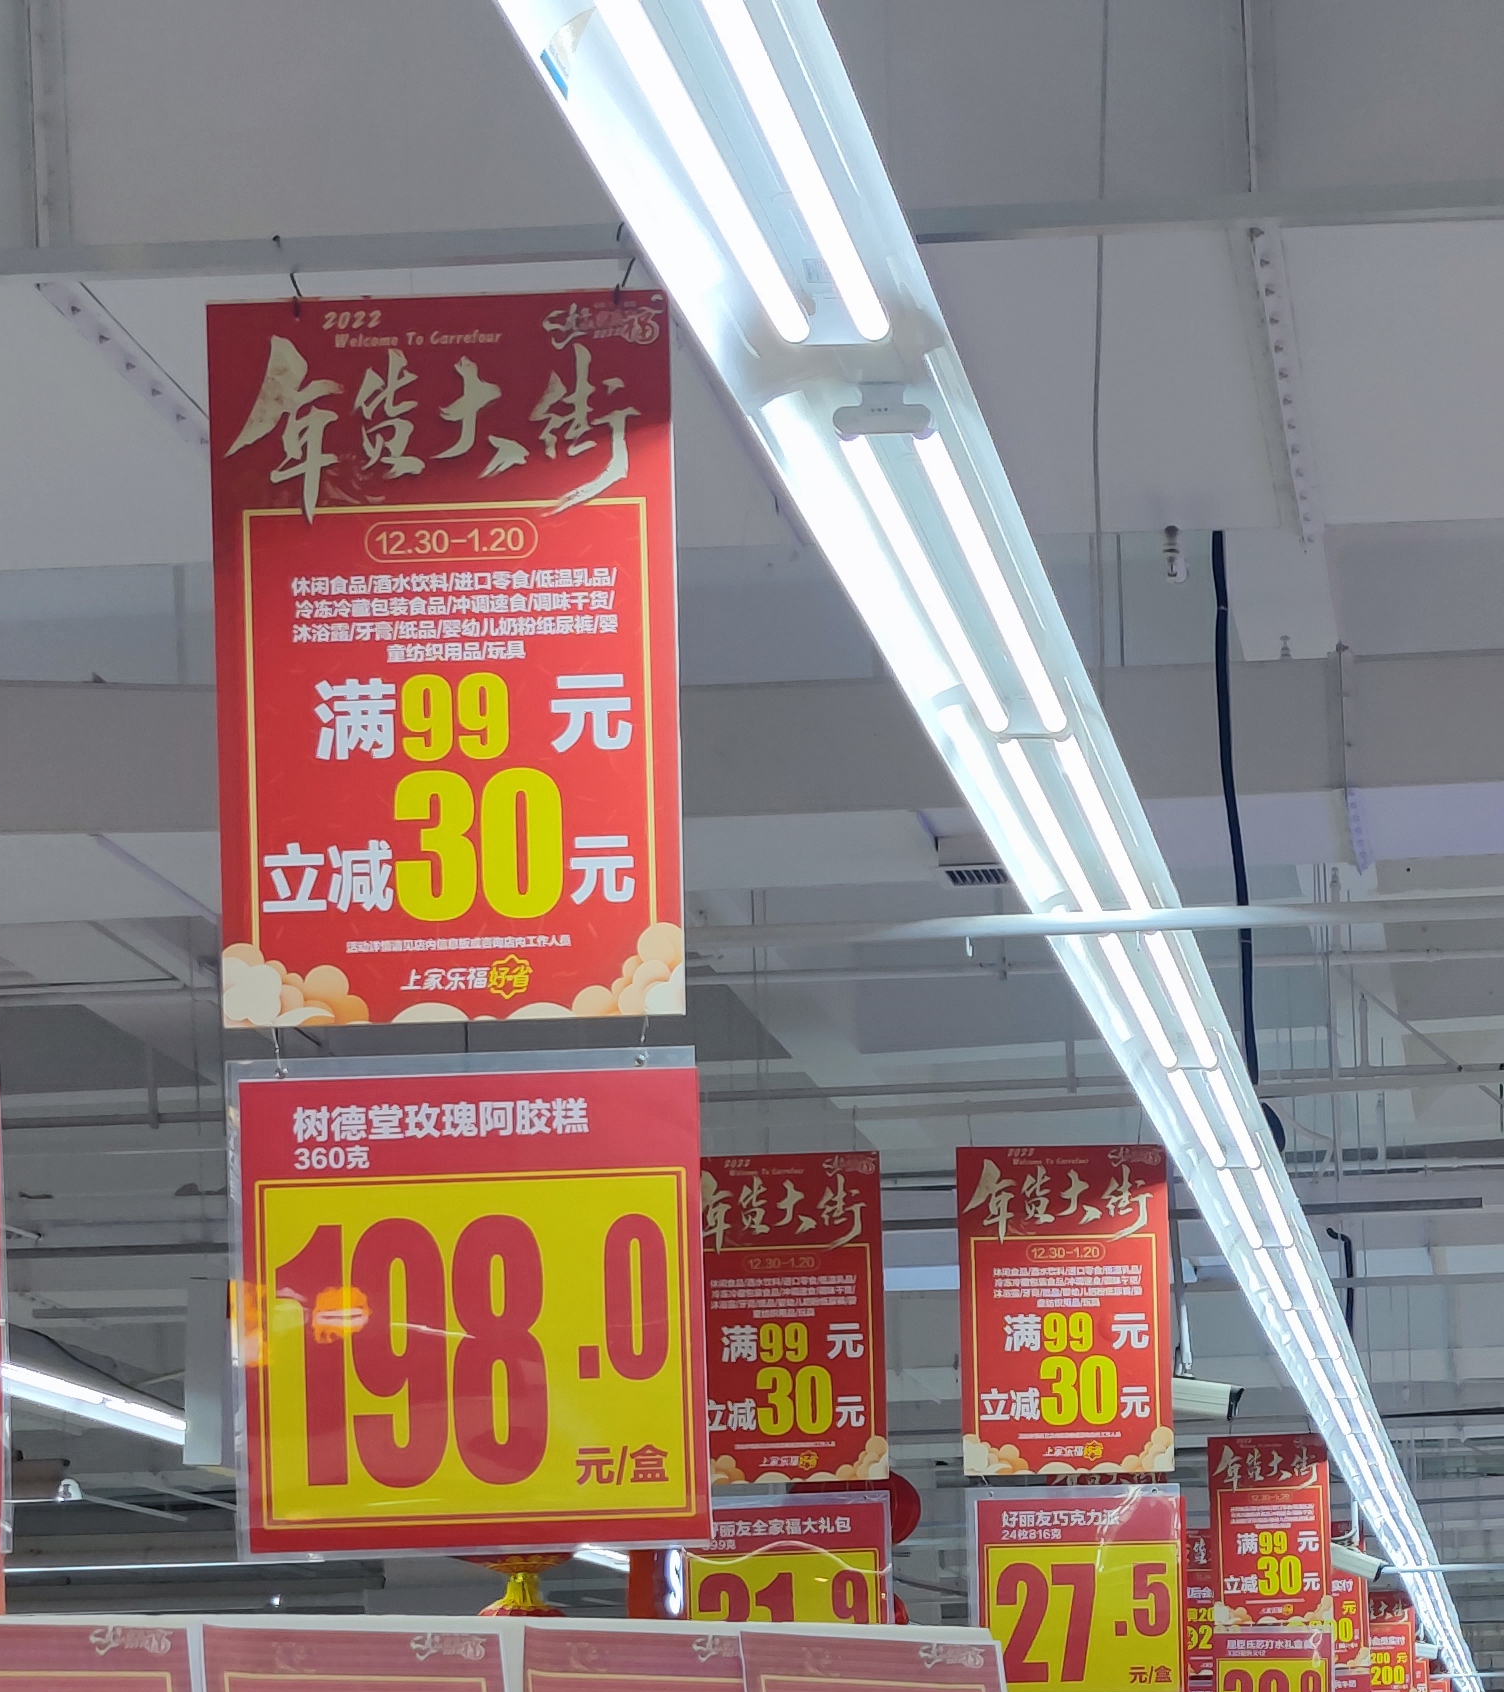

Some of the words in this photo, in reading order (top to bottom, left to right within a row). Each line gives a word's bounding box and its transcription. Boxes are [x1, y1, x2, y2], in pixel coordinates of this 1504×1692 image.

[322, 310, 382, 330] 2022
[335, 333, 398, 348] Welcome
[407, 332, 423, 346] To
[430, 330, 502, 346] Carrefour
[224, 335, 641, 525] 年货大街
[375, 527, 524, 556] 12.30-1.20
[550, 674, 632, 753] 元
[262, 767, 636, 922] 立减30元
[293, 1097, 589, 1143] 树德堂玫瑰阿胶糕
[294, 1145, 370, 1171] 360克
[962, 1159, 1153, 1245] 年货大街
[274, 1213, 669, 1489] 198.0
[826, 1322, 864, 1361] 元
[1111, 1311, 1150, 1350] 元
[980, 1354, 1151, 1427] 立减30元
[575, 1444, 669, 1485] 元/盒
[1224, 1556, 1321, 1597] 立减30元
[995, 1561, 1172, 1684] 27.5
[1128, 1663, 1173, 1685] 元/盒
